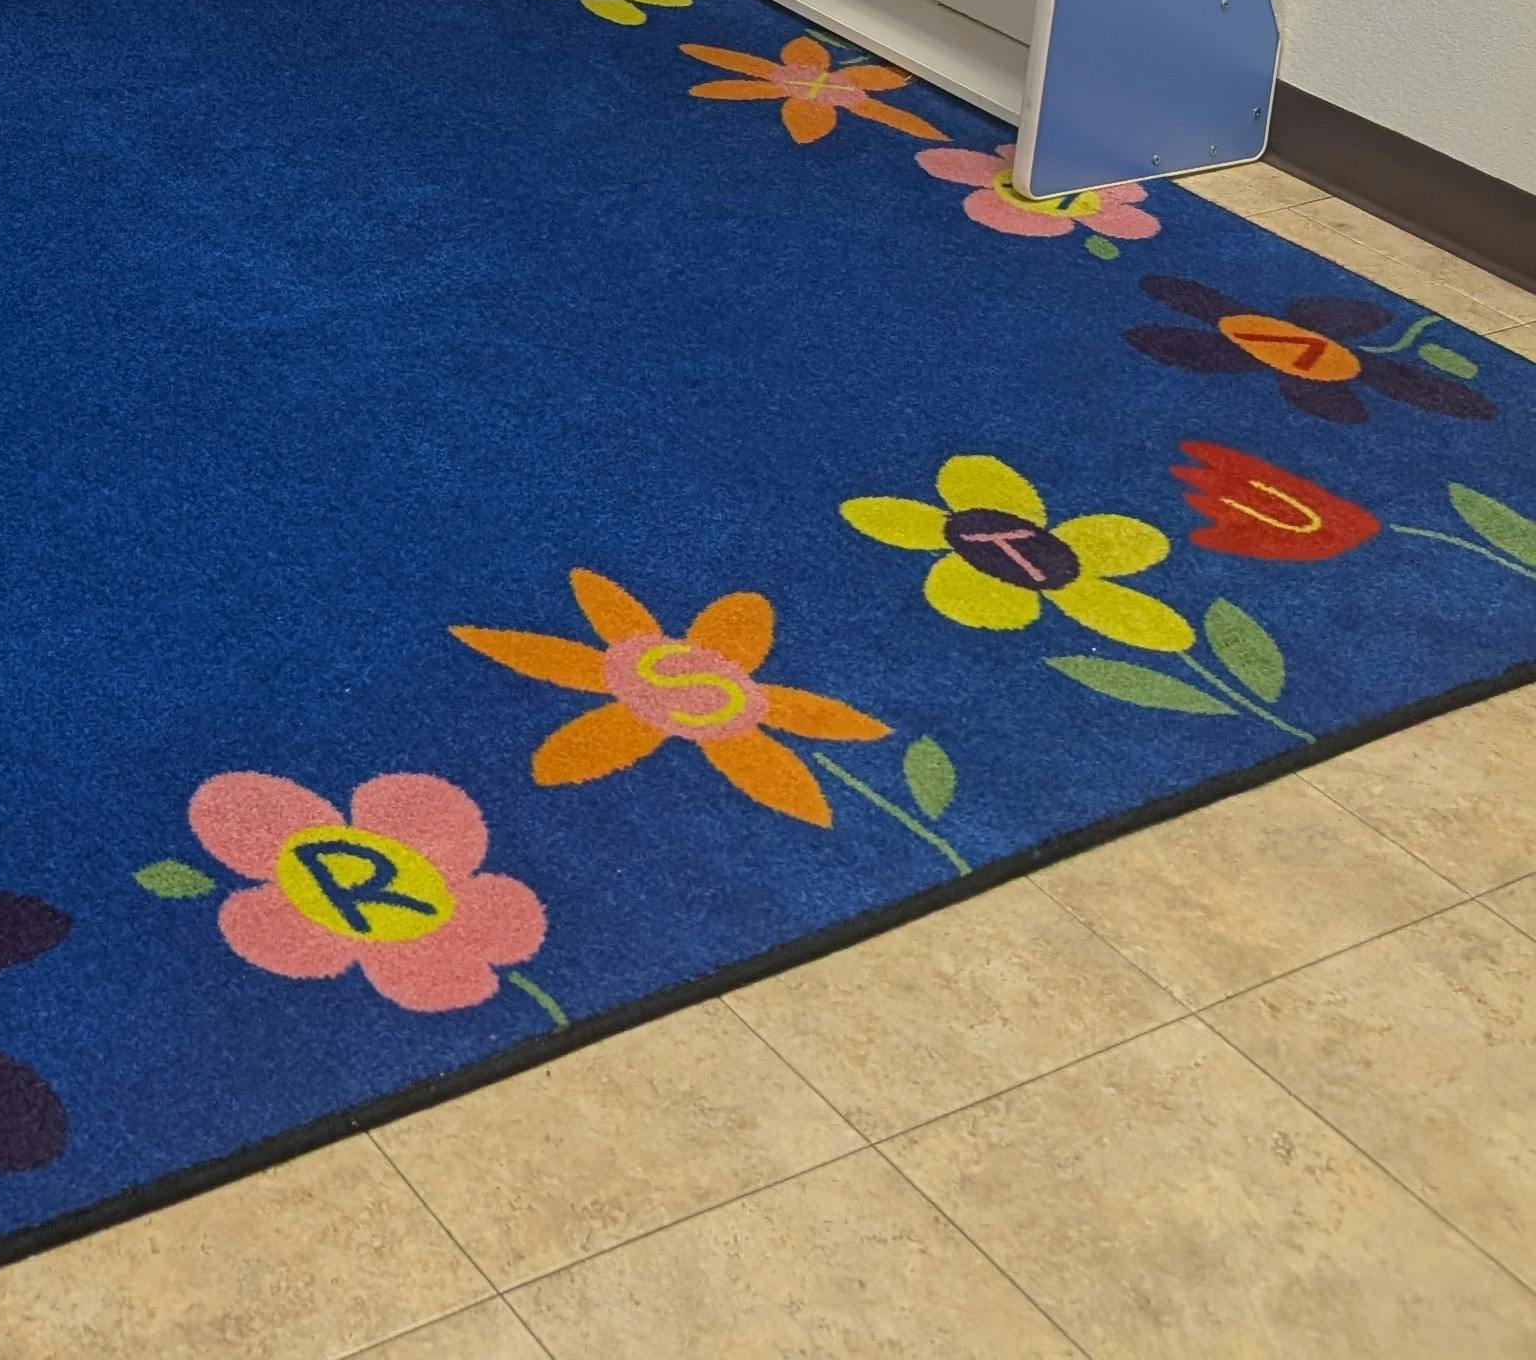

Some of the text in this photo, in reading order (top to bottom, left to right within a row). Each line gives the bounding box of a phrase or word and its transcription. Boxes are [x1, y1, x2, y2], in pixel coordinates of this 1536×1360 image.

[1220, 480, 1323, 533] U
[959, 528, 1046, 582] T
[635, 643, 746, 727] S
[293, 840, 438, 935] R
